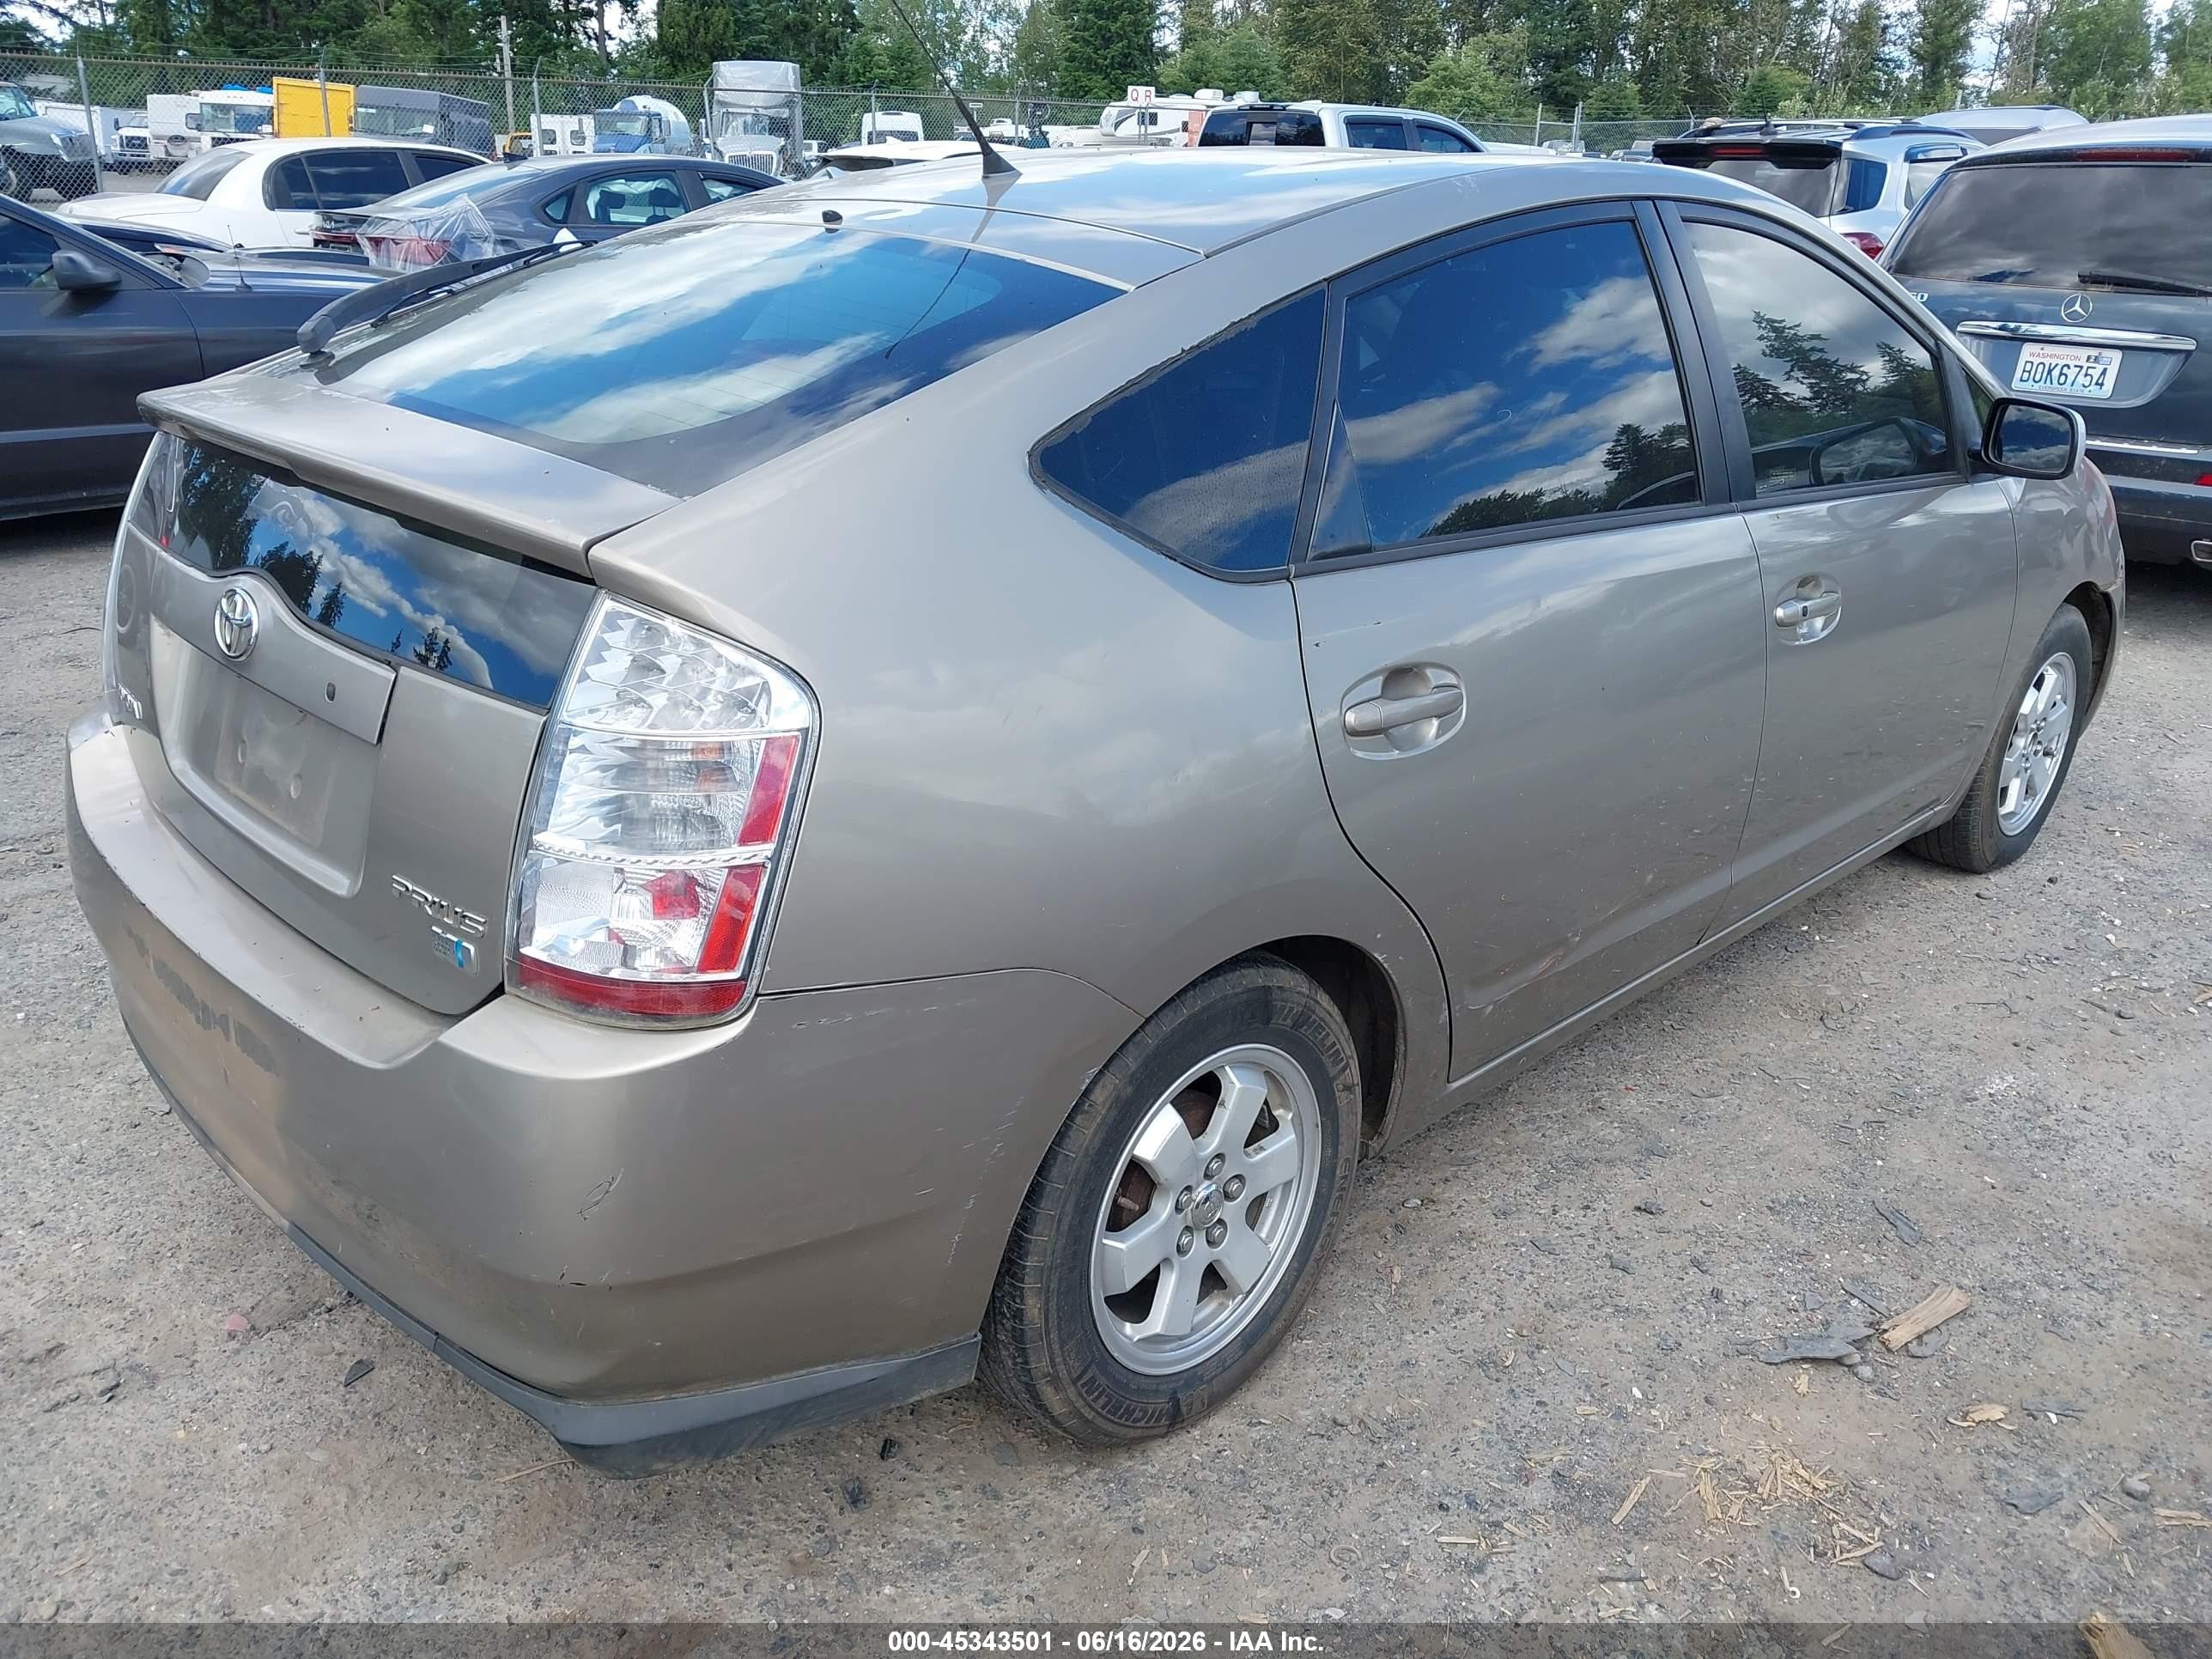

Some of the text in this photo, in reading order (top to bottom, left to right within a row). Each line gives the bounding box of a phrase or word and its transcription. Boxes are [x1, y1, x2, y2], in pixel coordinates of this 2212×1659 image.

[1130, 88, 1152, 103] Q R
[2028, 351, 2082, 362] WASHINGTON
[392, 874, 488, 938] PRIUS
